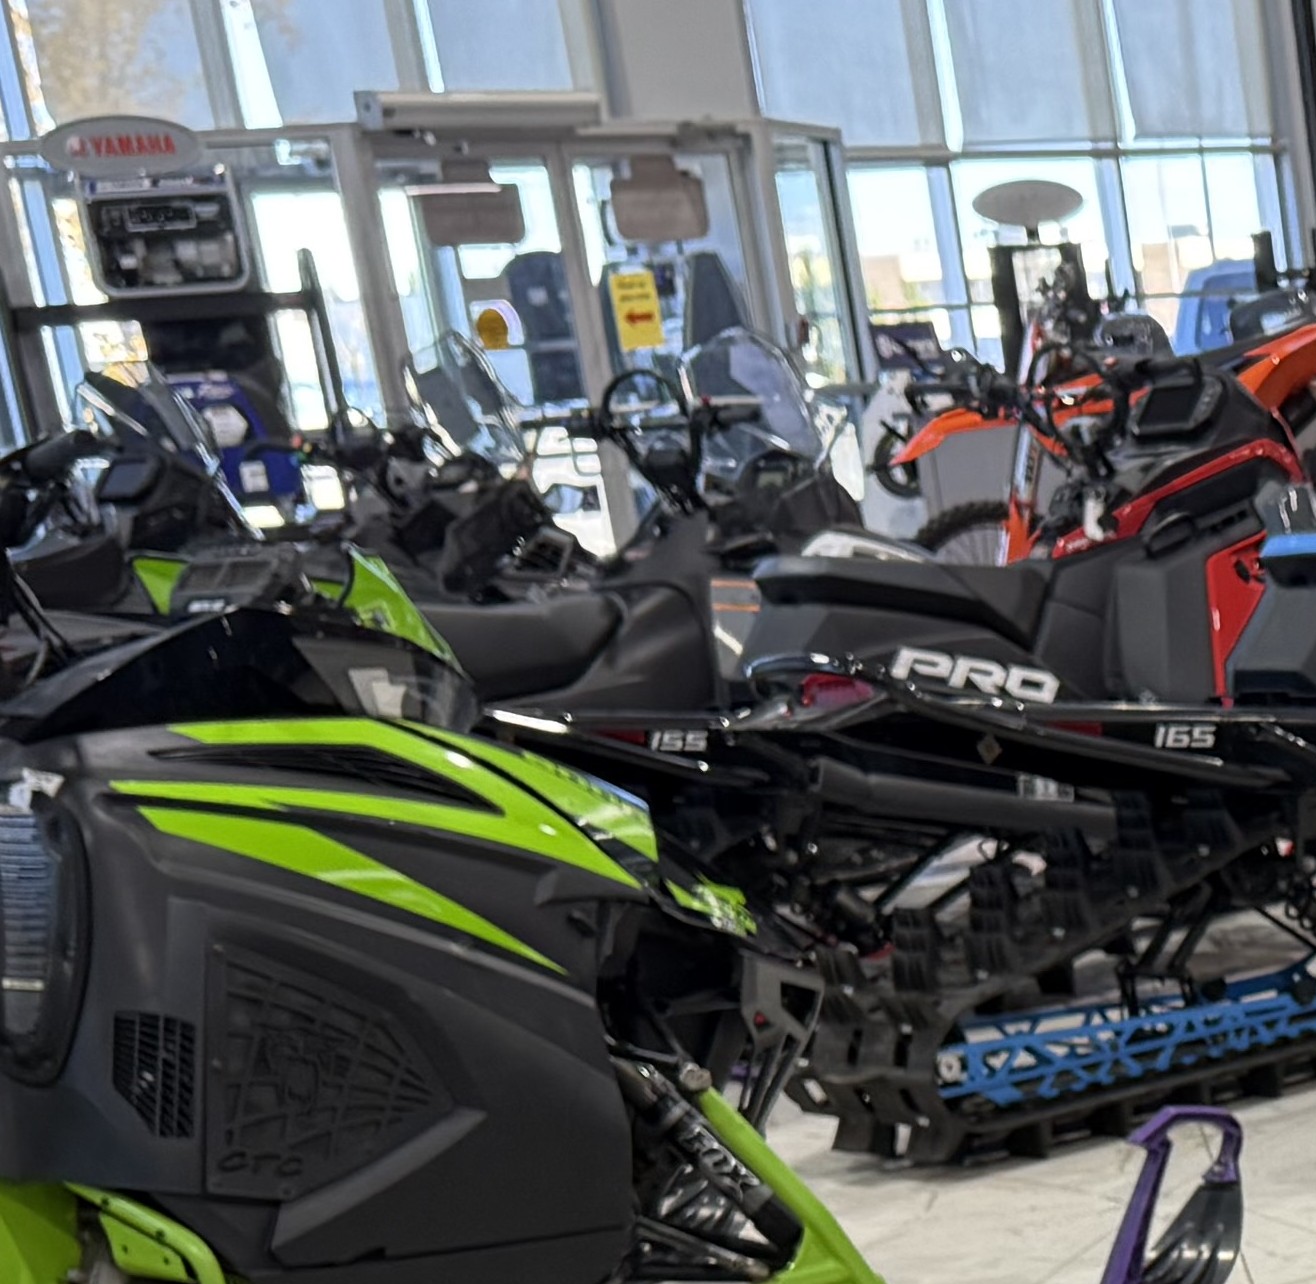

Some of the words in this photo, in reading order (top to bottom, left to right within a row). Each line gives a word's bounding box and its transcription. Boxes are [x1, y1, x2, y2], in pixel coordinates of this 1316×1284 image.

[90, 134, 176, 157] YAMAHA
[890, 646, 1060, 703] PRO
[1154, 723, 1217, 749] 165
